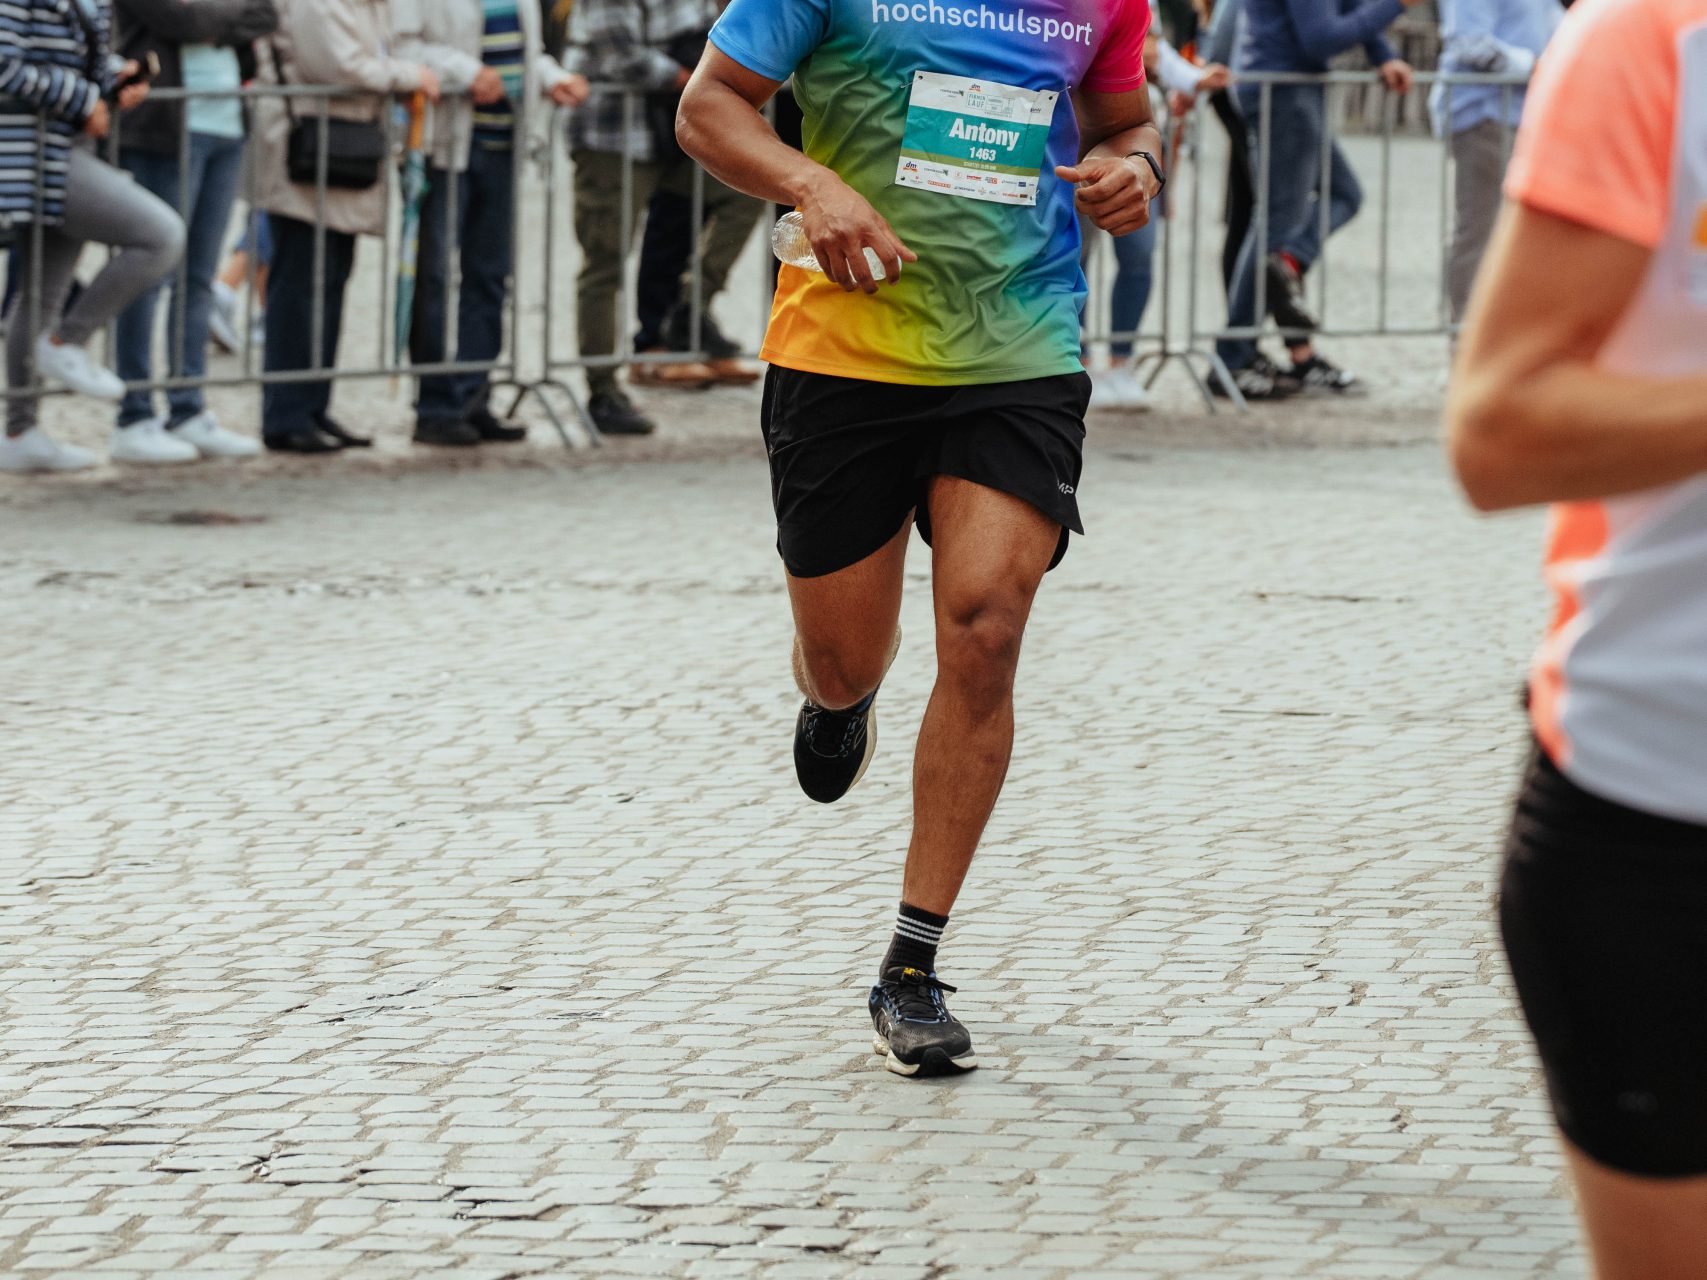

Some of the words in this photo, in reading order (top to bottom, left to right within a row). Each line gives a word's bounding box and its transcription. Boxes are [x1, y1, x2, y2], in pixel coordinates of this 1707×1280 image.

[949, 118, 1020, 151] Antony
[969, 146, 996, 161] 1463
[905, 161, 918, 169] dm
